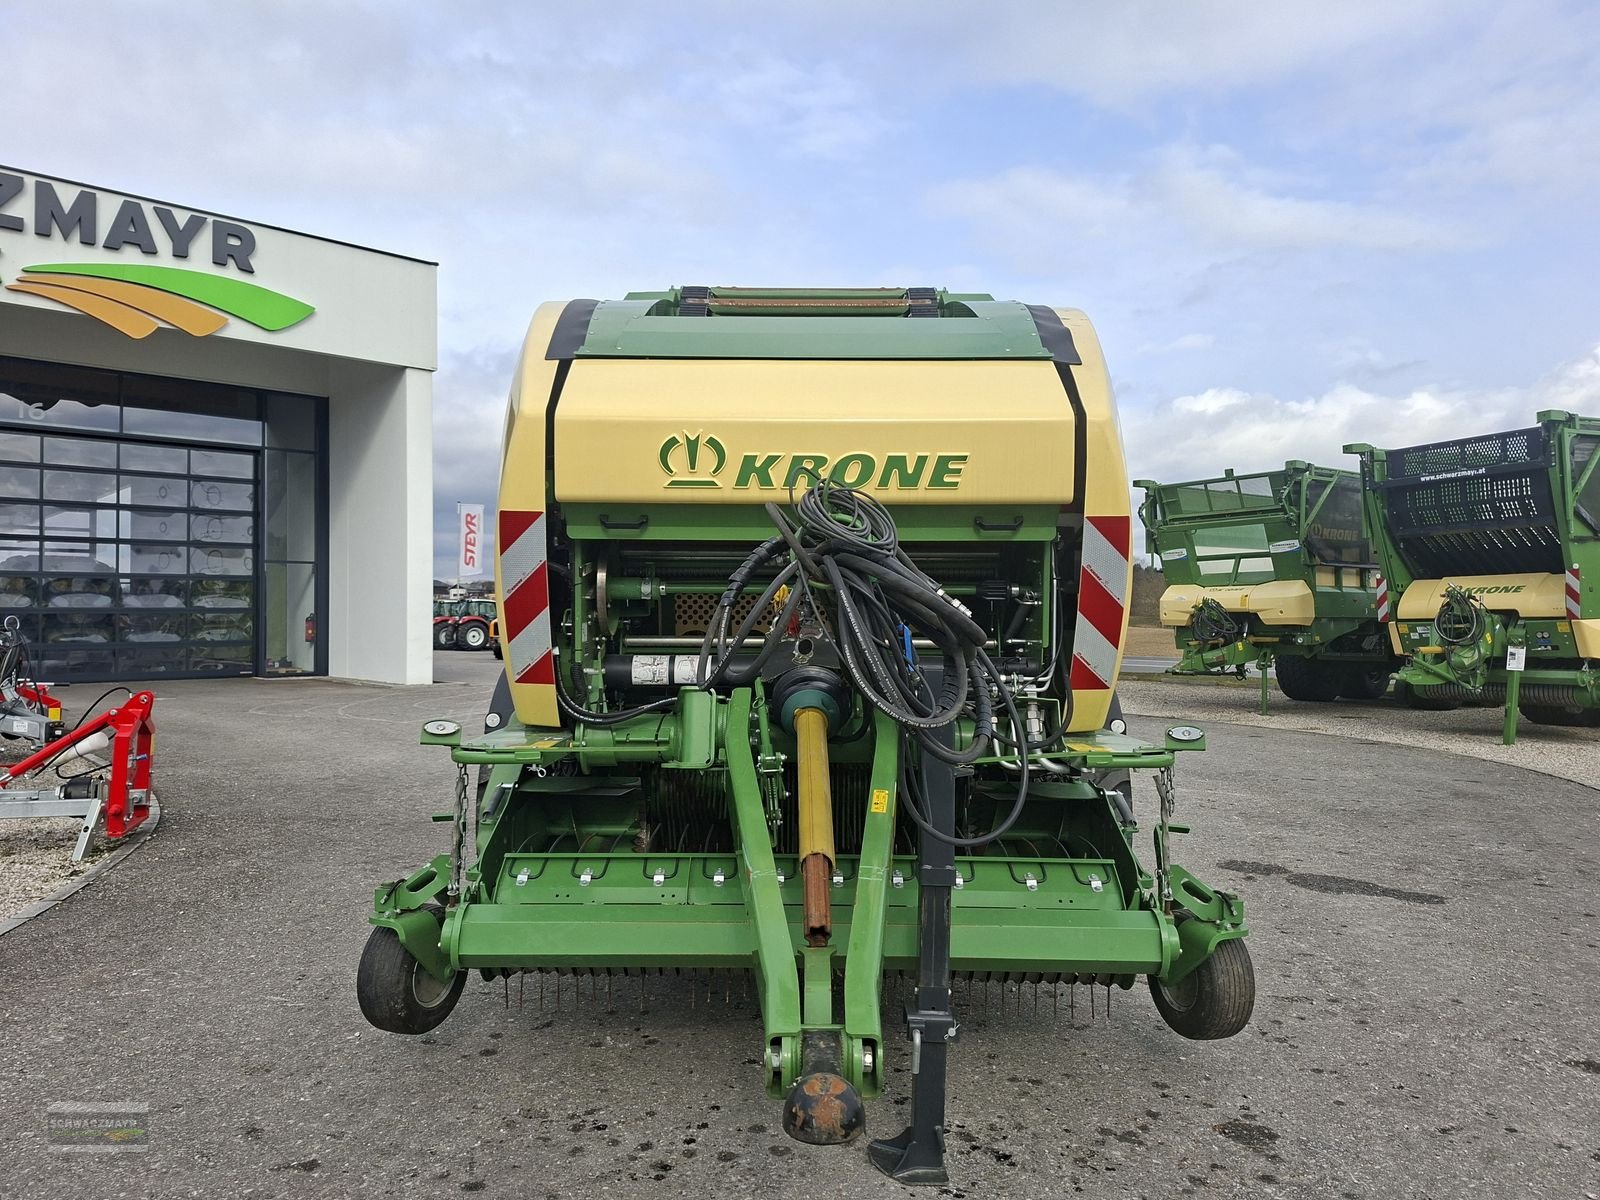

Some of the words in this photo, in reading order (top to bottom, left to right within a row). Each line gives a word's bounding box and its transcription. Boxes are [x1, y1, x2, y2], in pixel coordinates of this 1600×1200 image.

[733, 451, 970, 490] KRONE
[464, 512, 477, 568] STEYR
[1322, 527, 1360, 541] KRONE
[1463, 584, 1527, 595] KRONE
